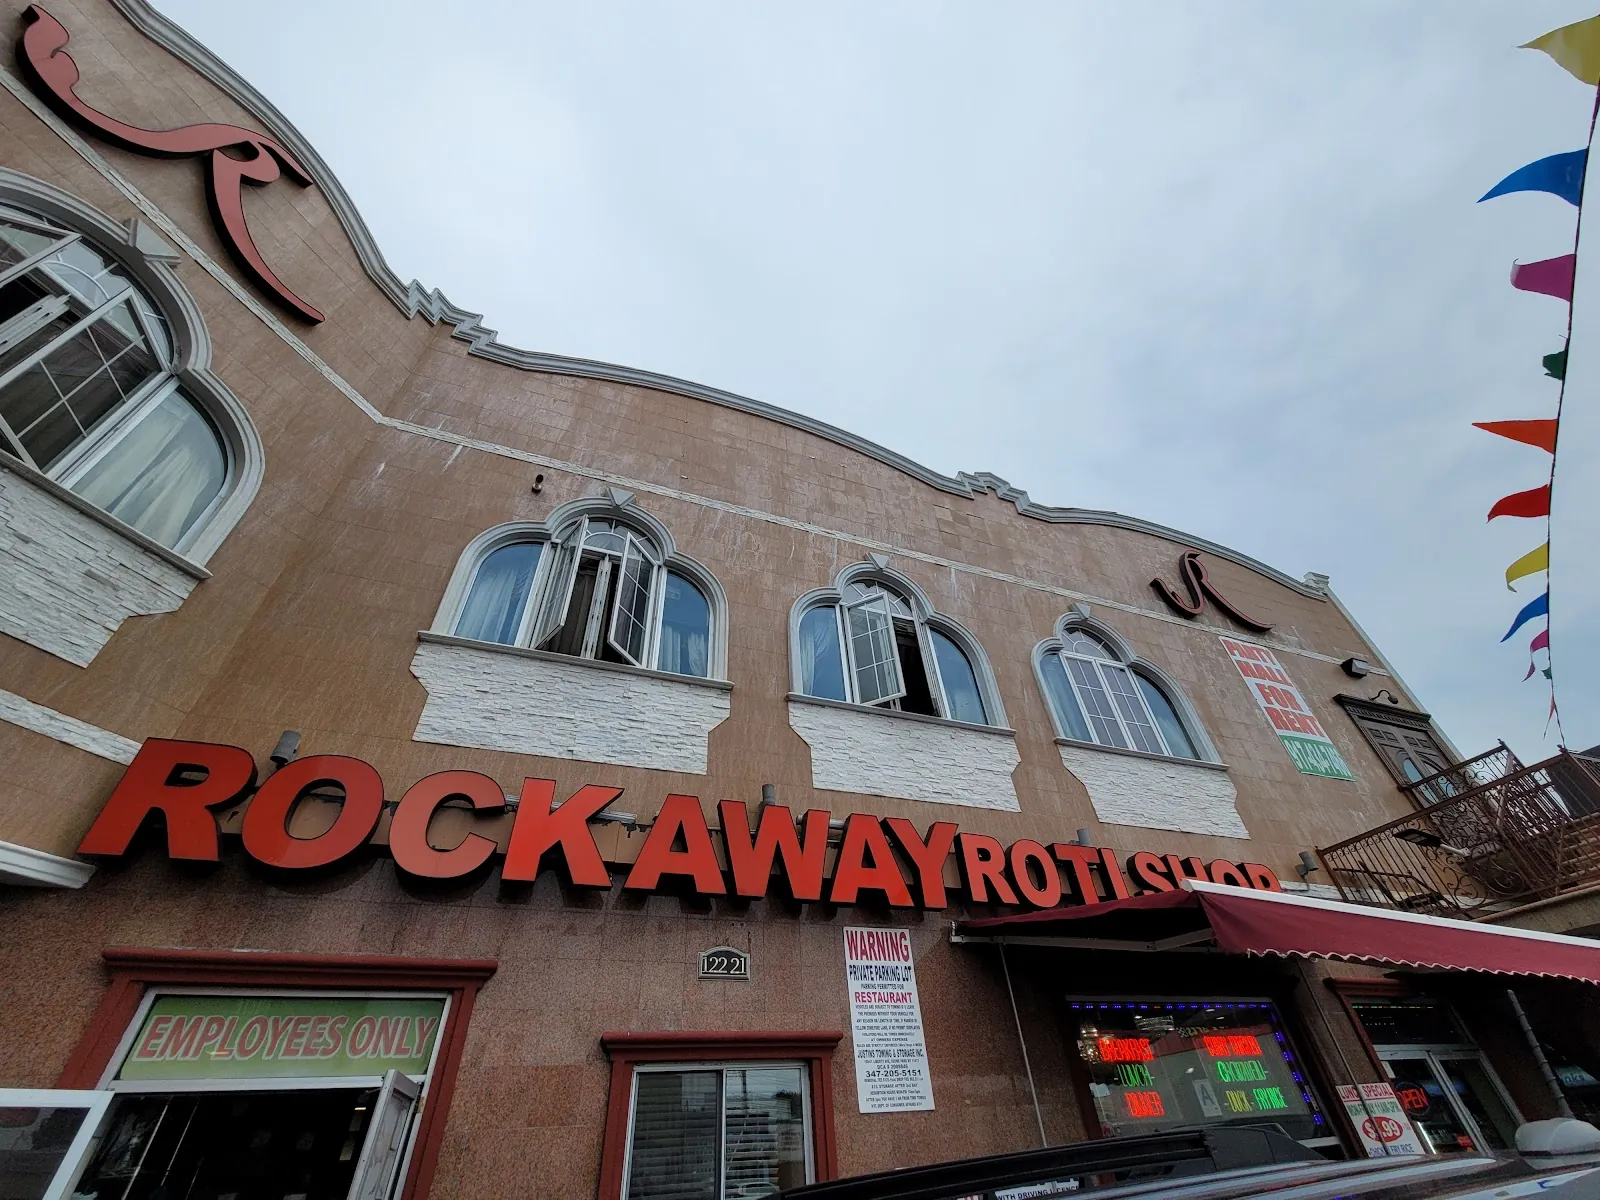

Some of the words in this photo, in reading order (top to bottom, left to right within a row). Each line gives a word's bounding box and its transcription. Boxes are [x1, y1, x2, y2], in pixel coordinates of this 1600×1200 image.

[1222, 639, 1276, 665] PARTY
[1236, 660, 1294, 688] HALL
[1254, 682, 1304, 713] FOR
[1264, 706, 1327, 738] RENT
[77, 736, 959, 911] ROCKAWAY
[957, 832, 1131, 908] ROTI
[846, 929, 910, 962] WARNING
[849, 964, 874, 981] PRIVATE
[874, 965, 901, 981] PARKING
[900, 965, 912, 982] LOT
[854, 991, 912, 1003] RESTAURANT
[133, 1015, 350, 1061] EMPLOYEES
[346, 1015, 440, 1061] ONLY
[1097, 1037, 1155, 1062] BREAKFAST
[857, 1048, 875, 1058] JUSTINS
[875, 1048, 892, 1058] TOWING
[896, 1048, 915, 1057] STORAGE
[915, 1048, 924, 1057] INC.
[865, 1069, 921, 1077] 347-205-5151
[1338, 1085, 1360, 1100] LUNC
[1362, 1083, 1394, 1098] SPECIAL
[1124, 1091, 1165, 1118] DINNER
[1364, 1119, 1401, 1140] $.99
[1017, 1189, 1051, 1199] DRIVING
